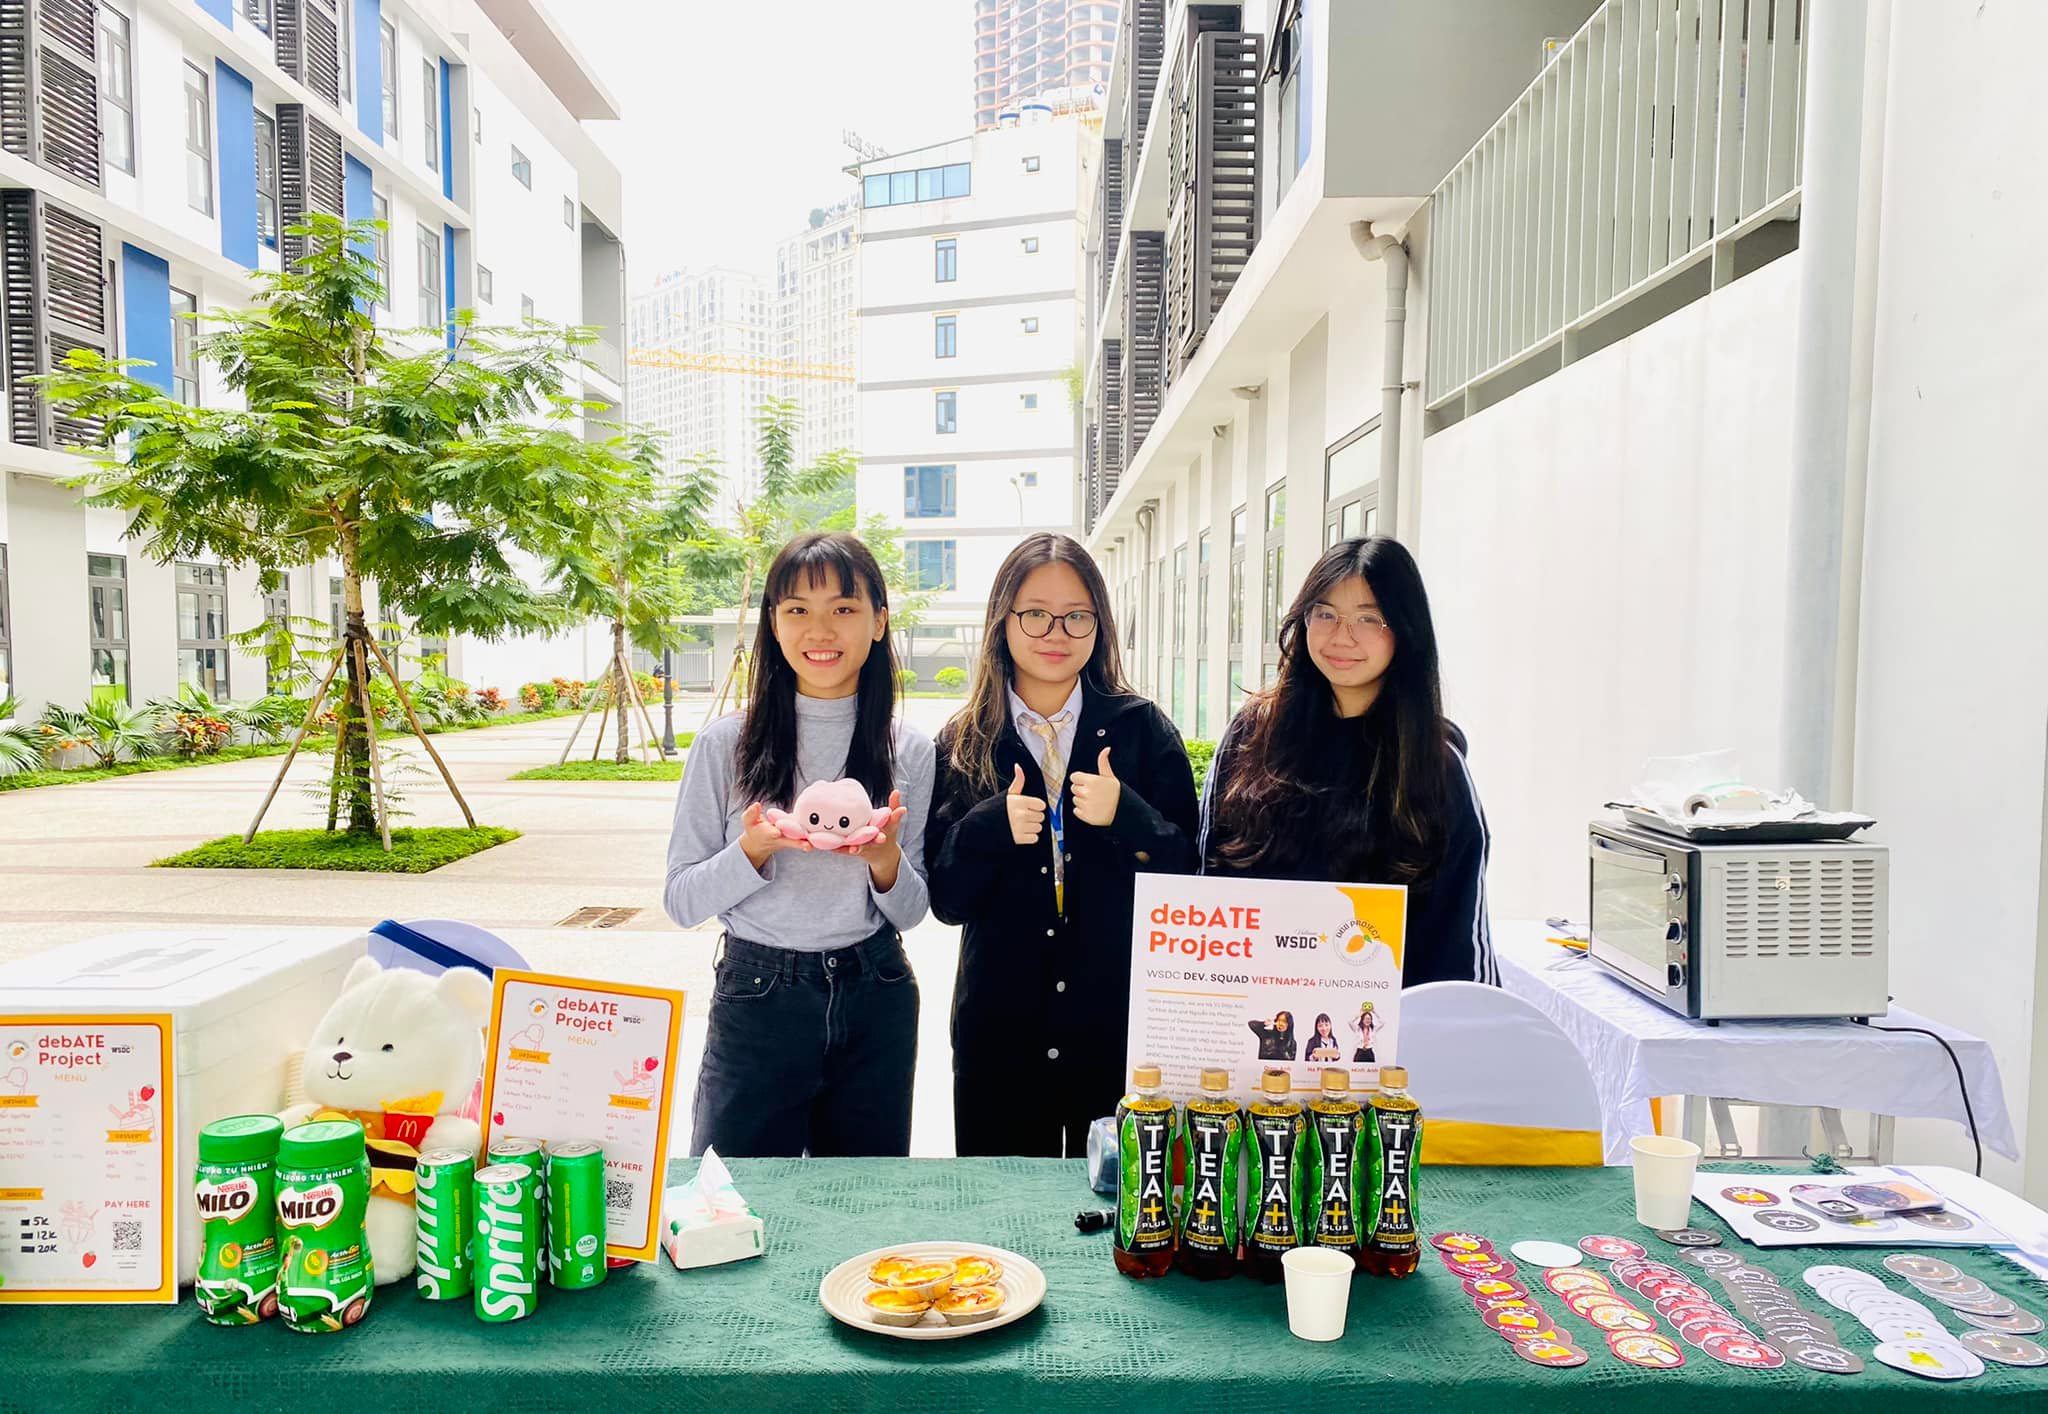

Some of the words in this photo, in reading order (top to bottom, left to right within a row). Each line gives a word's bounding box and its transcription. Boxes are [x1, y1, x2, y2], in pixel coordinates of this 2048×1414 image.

[1150, 903, 1261, 931] debATE
[1149, 931, 1253, 961] Project
[1275, 935, 1318, 949] WSDC
[1146, 969, 1182, 980] WSDC
[1183, 972, 1208, 982] DEV.
[1210, 973, 1249, 984] SQUAD
[1251, 976, 1316, 987] VIETNAM'24
[1318, 978, 1390, 989] FUNDRAISING
[557, 997, 619, 1016] debATE
[555, 1013, 613, 1033] Project
[38, 1034, 105, 1048] debATE
[567, 1035, 597, 1047] MENU
[39, 1052, 102, 1068] Project
[54, 1074, 87, 1082] MENU
[622, 1162, 643, 1171] HERE
[127, 1200, 150, 1208] HERE
[197, 1191, 250, 1212] MILO
[281, 1197, 336, 1219] MILO
[1142, 1220, 1166, 1229] PLUS
[1192, 1222, 1217, 1231] PLUS
[478, 1182, 532, 1320] Sprite
